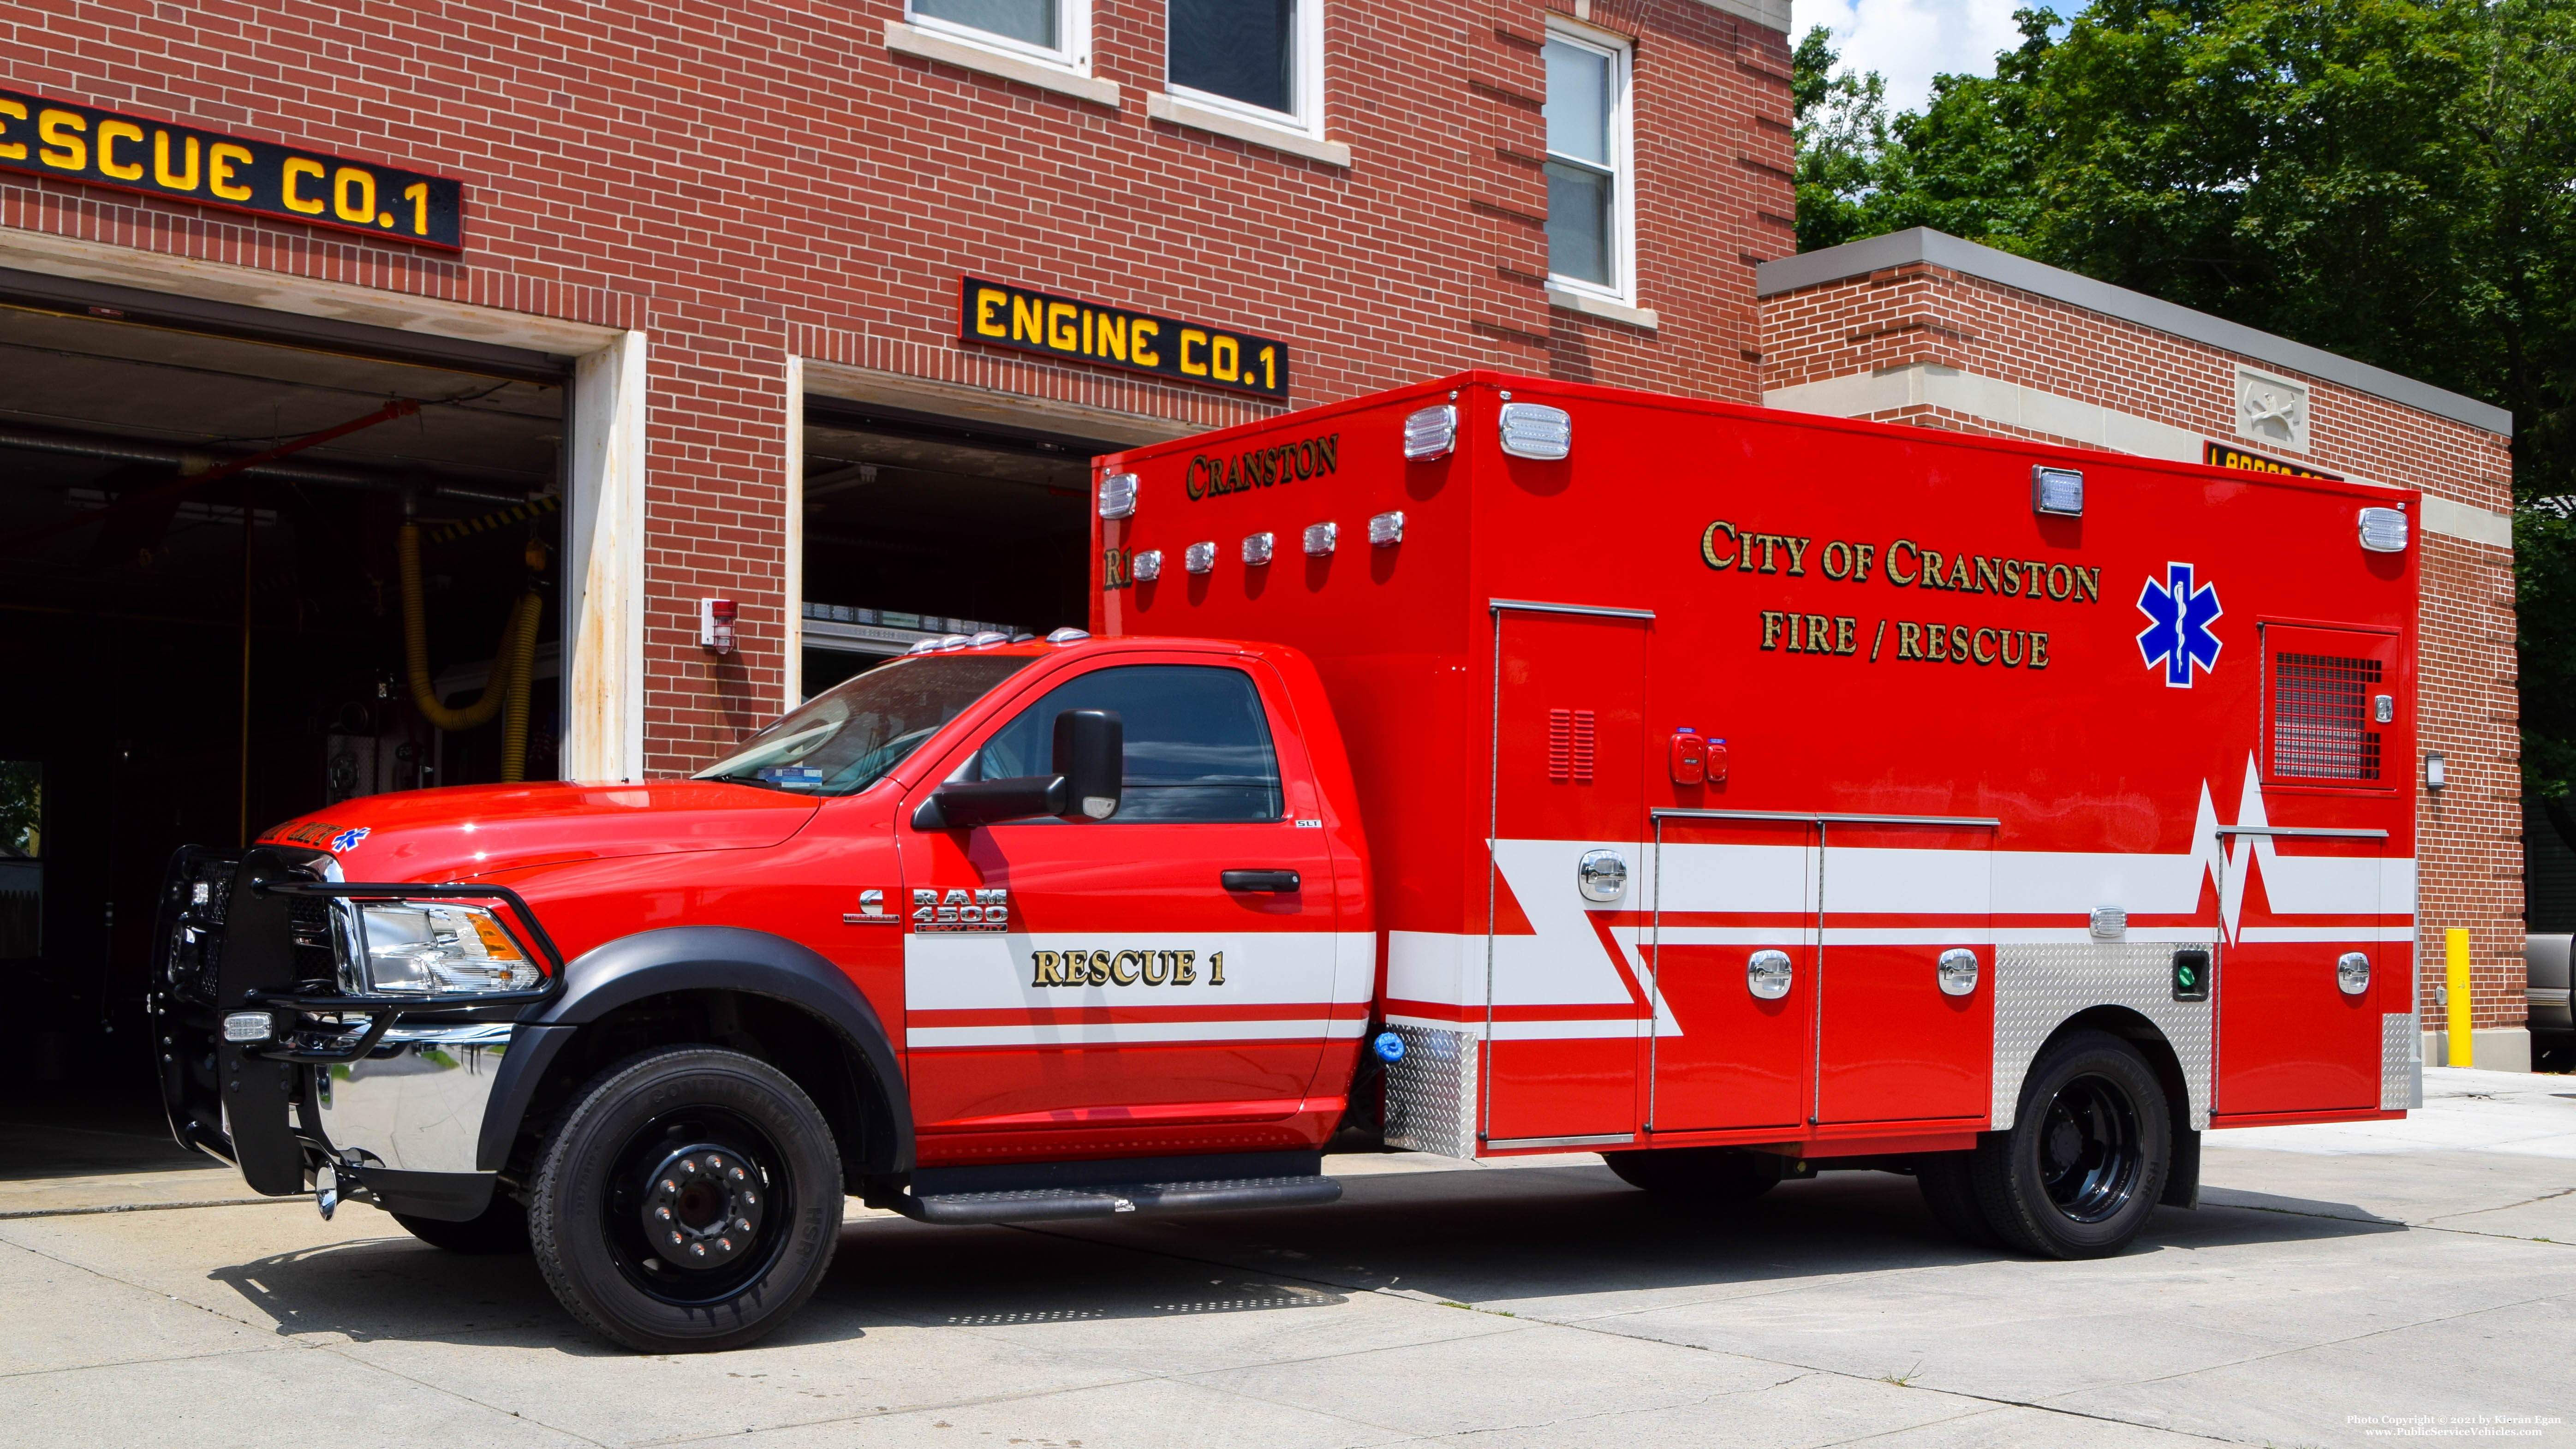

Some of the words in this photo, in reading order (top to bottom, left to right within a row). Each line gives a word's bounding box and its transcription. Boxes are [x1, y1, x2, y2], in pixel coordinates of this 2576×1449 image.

[282, 157, 429, 236] CO.1
[976, 288, 1159, 367] ENGINE
[1180, 328, 1276, 390] CO.1
[1103, 547, 1133, 592] R1
[1821, 540, 1875, 580] OF
[1759, 610, 1858, 654] FIRE
[1896, 621, 2050, 670] RESCUE
[912, 889, 1007, 905] RAM
[912, 906, 1008, 922] 4500
[1032, 950, 1196, 987] RESCUE
[1209, 951, 1226, 986] 1
